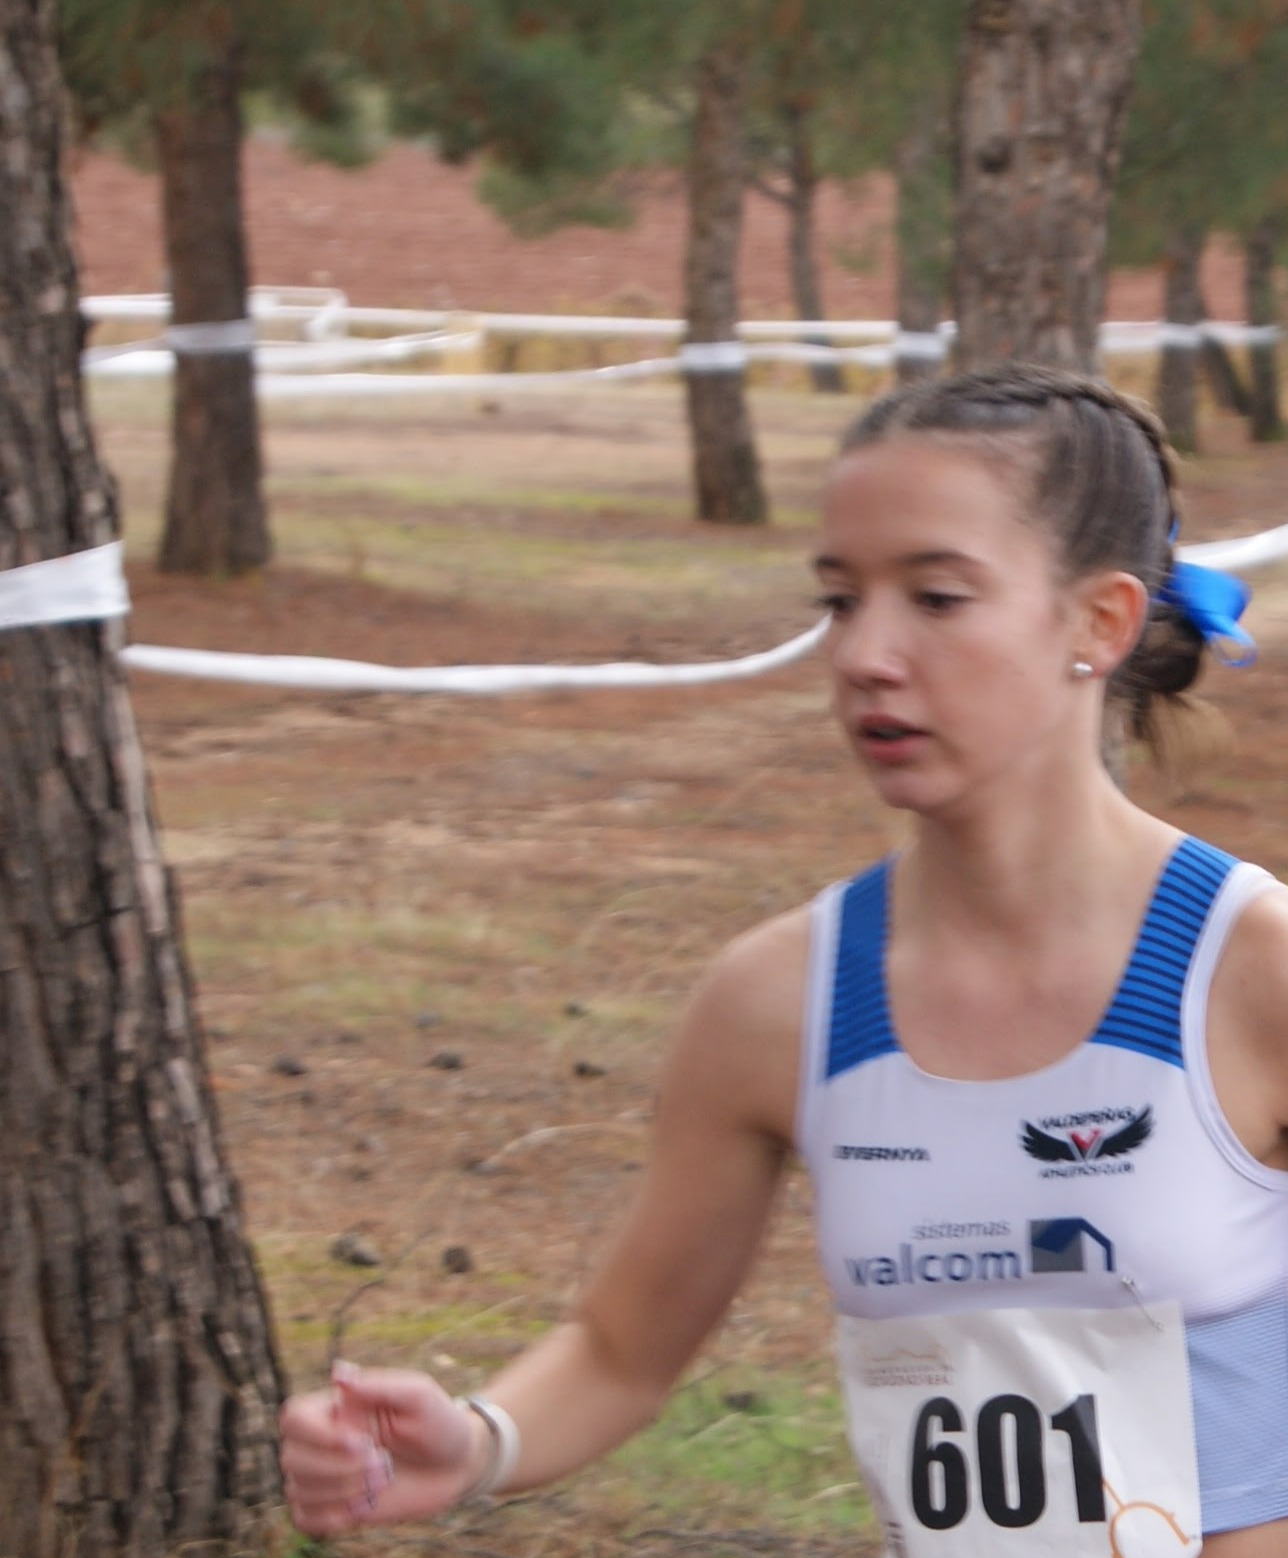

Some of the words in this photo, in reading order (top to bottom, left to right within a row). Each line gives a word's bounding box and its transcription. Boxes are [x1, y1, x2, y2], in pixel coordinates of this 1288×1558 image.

[911, 1219, 1011, 1240] sistemas
[844, 1242, 1022, 1287] valcom
[911, 1393, 1106, 1531] 601
